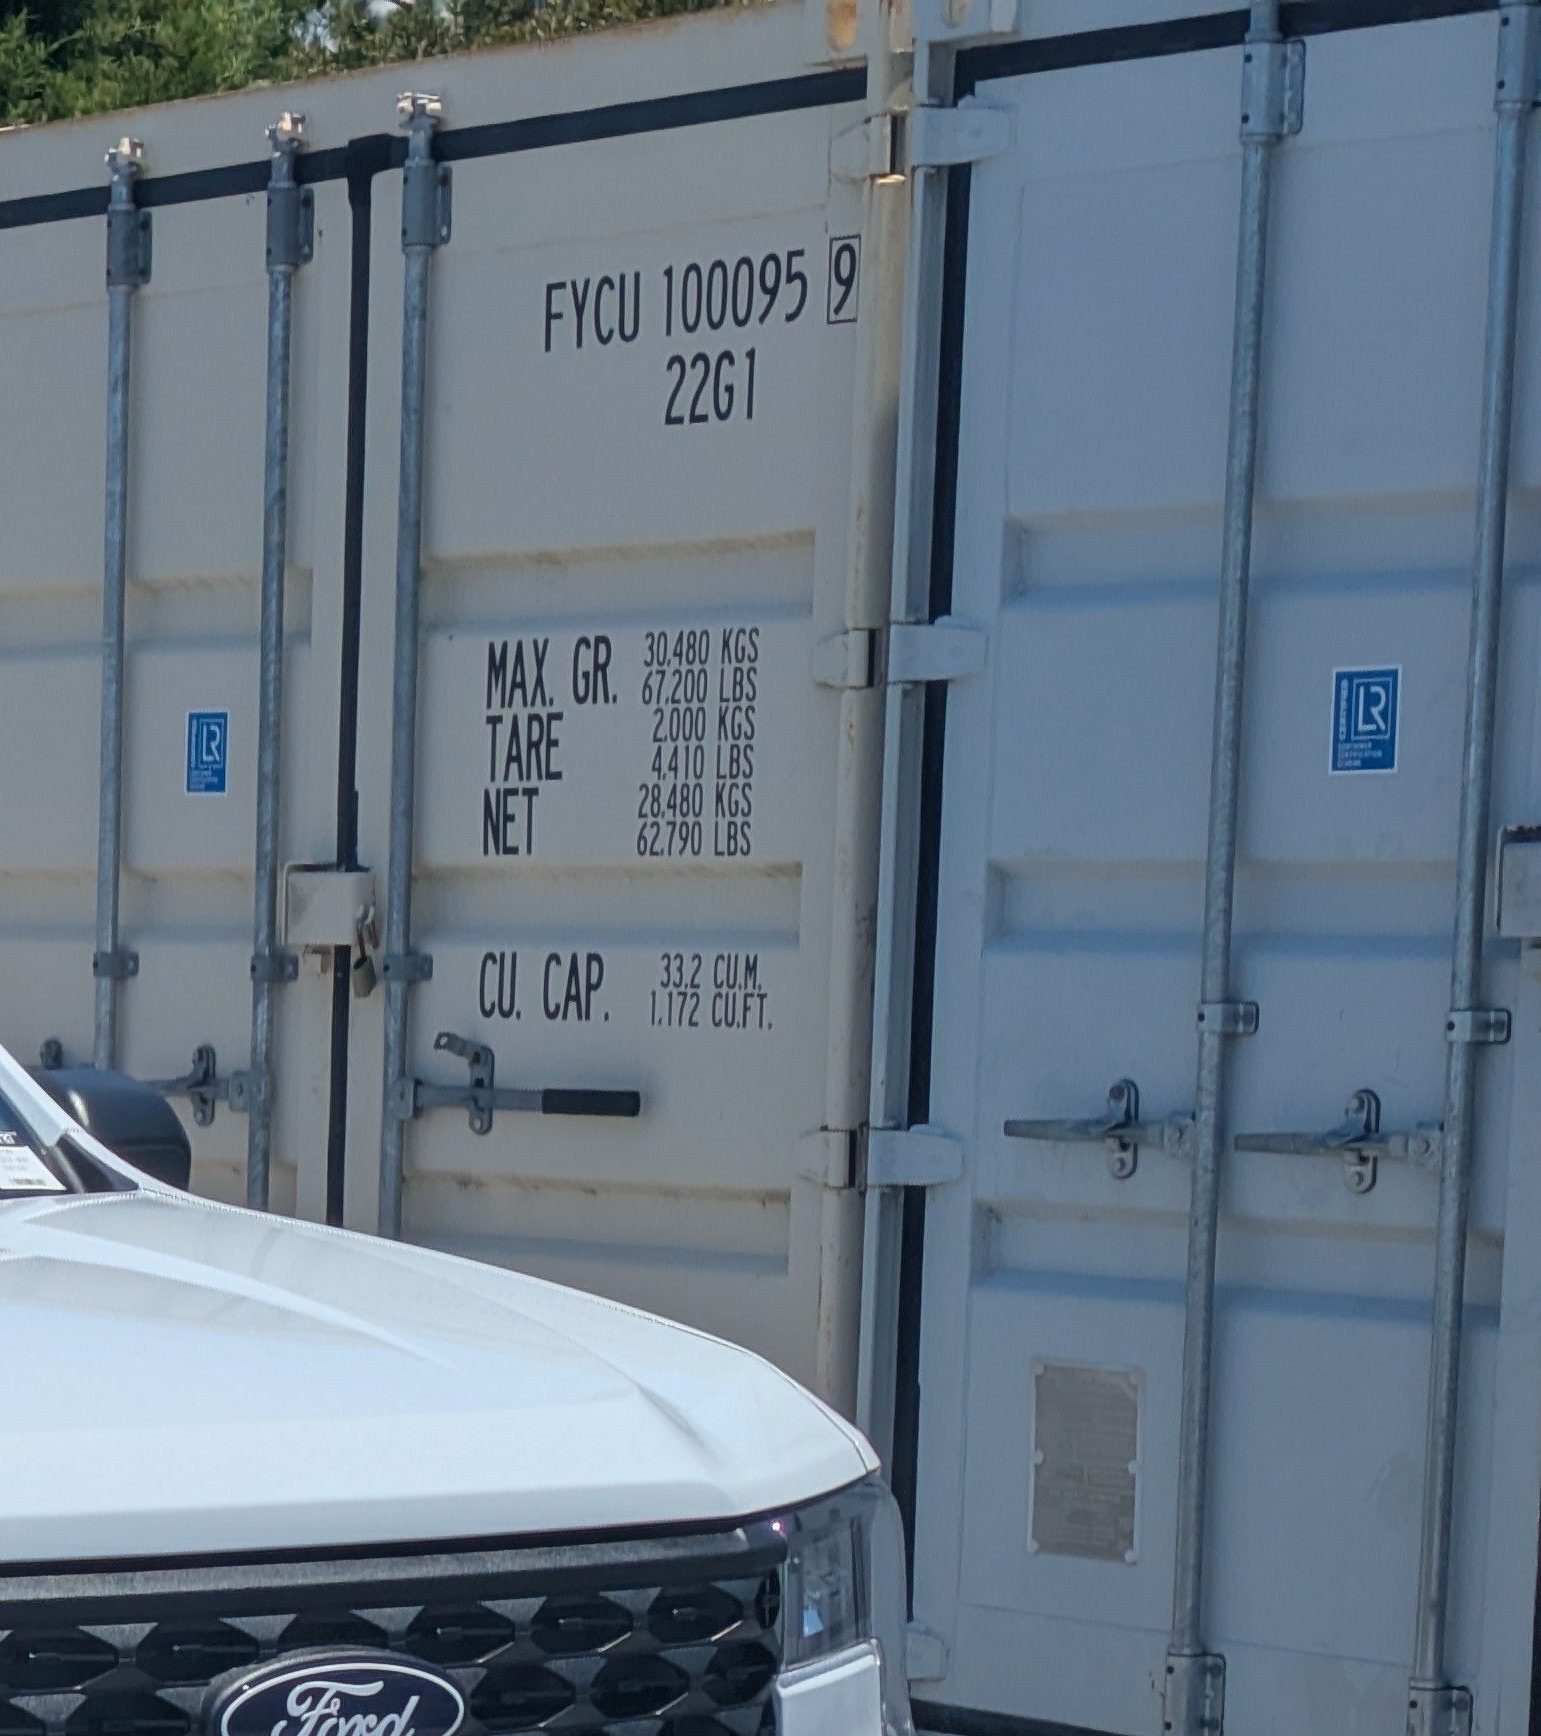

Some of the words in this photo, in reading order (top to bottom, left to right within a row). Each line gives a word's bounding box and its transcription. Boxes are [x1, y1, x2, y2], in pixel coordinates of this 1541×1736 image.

[544, 271, 641, 353] FYCU
[662, 248, 809, 337] 100095
[833, 242, 857, 316] 9
[664, 347, 757, 426] 22G1
[720, 627, 760, 666] KGS
[486, 637, 554, 709] MAX.
[572, 634, 618, 706] GR.
[719, 666, 757, 703] LBS
[717, 704, 756, 742] KGS
[486, 712, 564, 782] TARE
[716, 743, 754, 780] LBS
[715, 781, 752, 819] KGS
[482, 787, 540, 857] NET
[714, 820, 752, 857] LBS
[479, 951, 522, 1021] CU.
[543, 951, 610, 1023] CAP.
[713, 952, 763, 991] CU.M.
